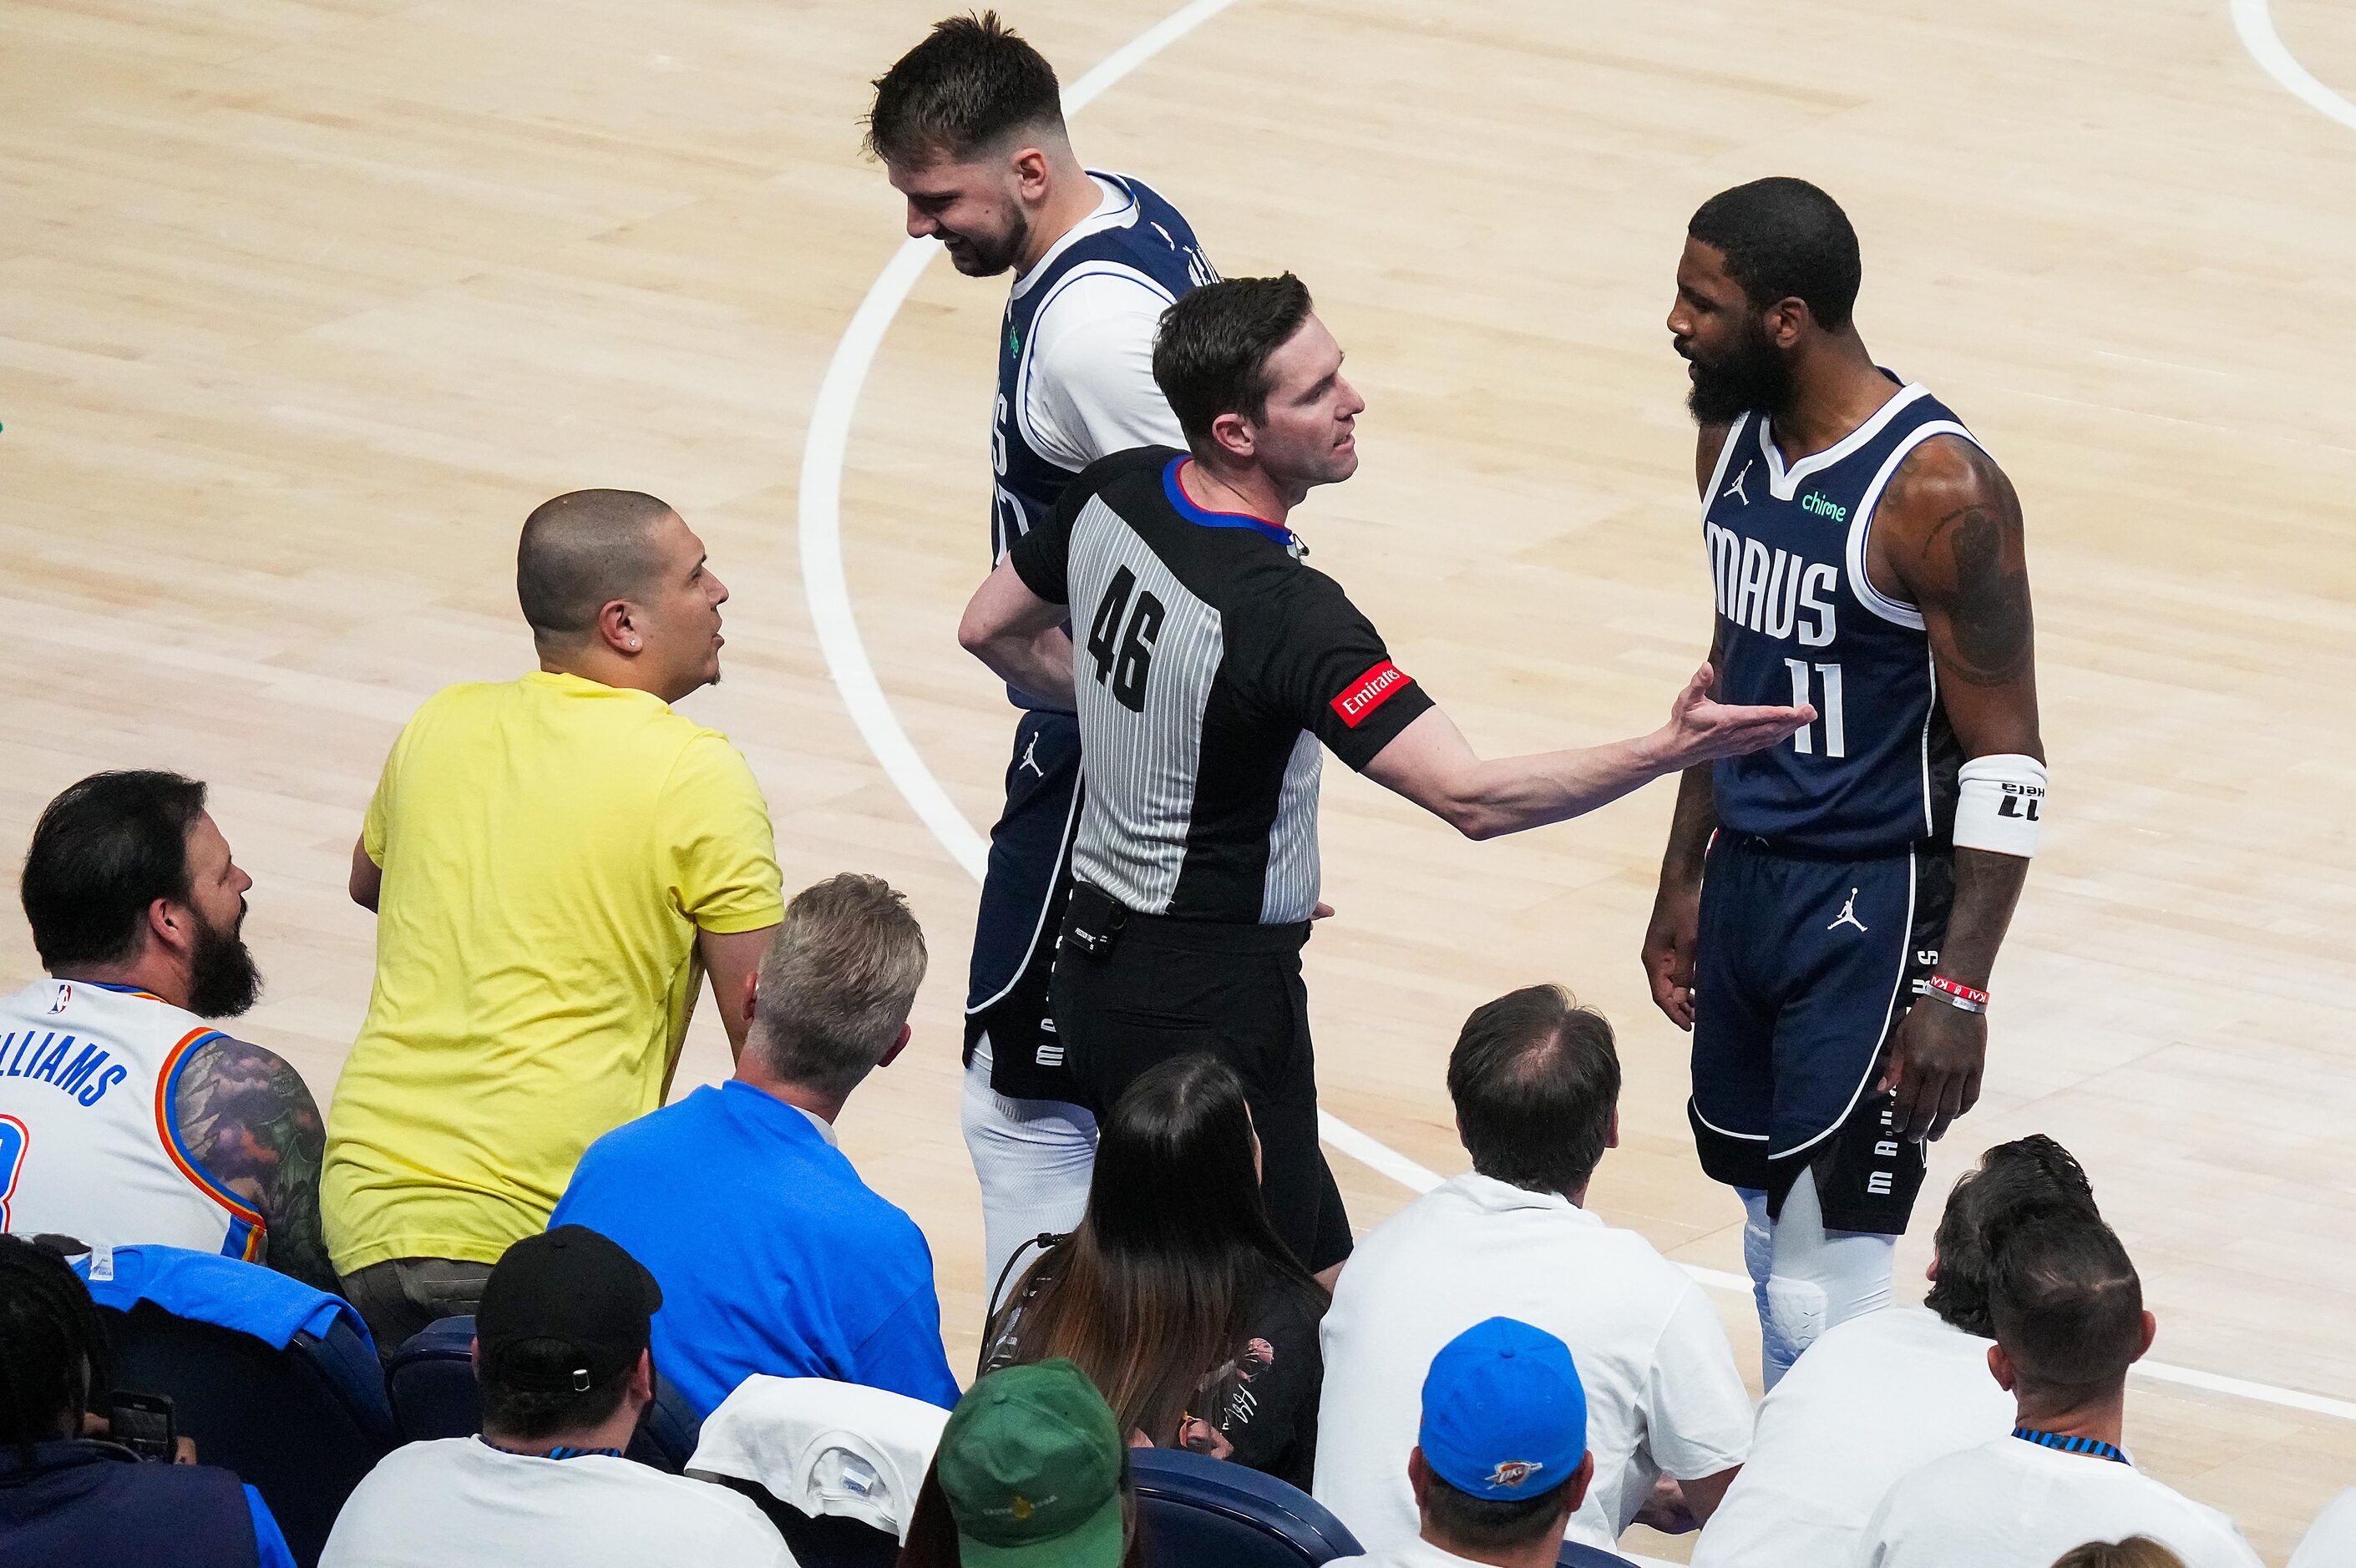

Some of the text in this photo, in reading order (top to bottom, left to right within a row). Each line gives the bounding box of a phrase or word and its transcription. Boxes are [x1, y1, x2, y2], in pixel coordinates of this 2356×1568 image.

[1802, 491, 1847, 523] chime
[1707, 521, 1838, 647] MAVS
[1087, 564, 1166, 713] 46
[1784, 658, 1845, 758] 11
[1998, 795, 2039, 822] 11
[0, 1030, 128, 1107] LLIAMS
